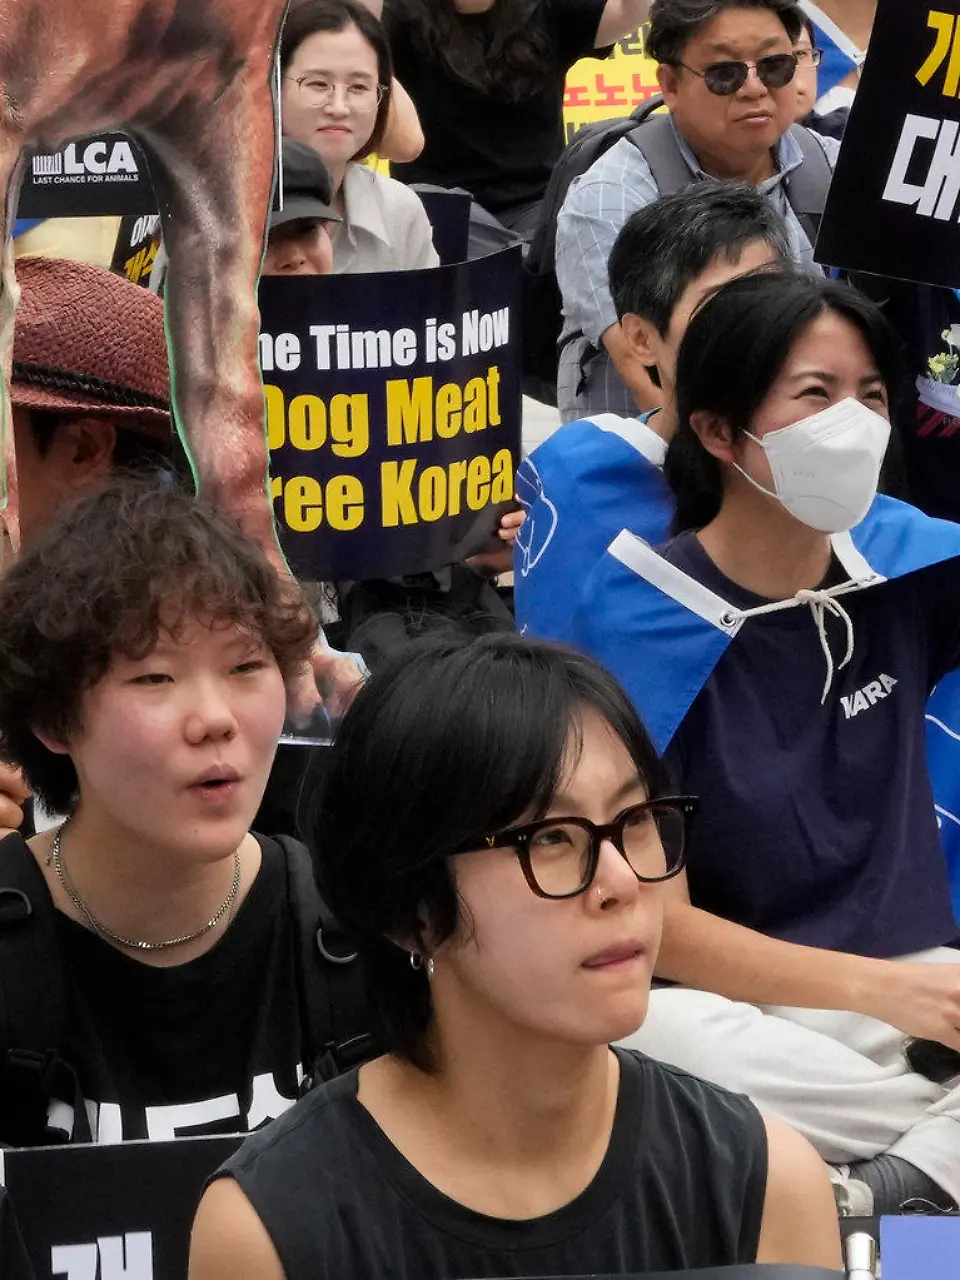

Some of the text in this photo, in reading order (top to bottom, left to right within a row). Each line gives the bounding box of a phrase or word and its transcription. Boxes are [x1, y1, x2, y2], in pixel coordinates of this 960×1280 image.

[33, 174, 139, 185] LAST CHANCE FOR ANIMALS
[63, 141, 139, 174] LCA
[309, 324, 418, 370] Time
[425, 318, 456, 364] is
[462, 307, 510, 358] Now
[263, 366, 502, 458] Dog Meat
[380, 448, 514, 528] Korea
